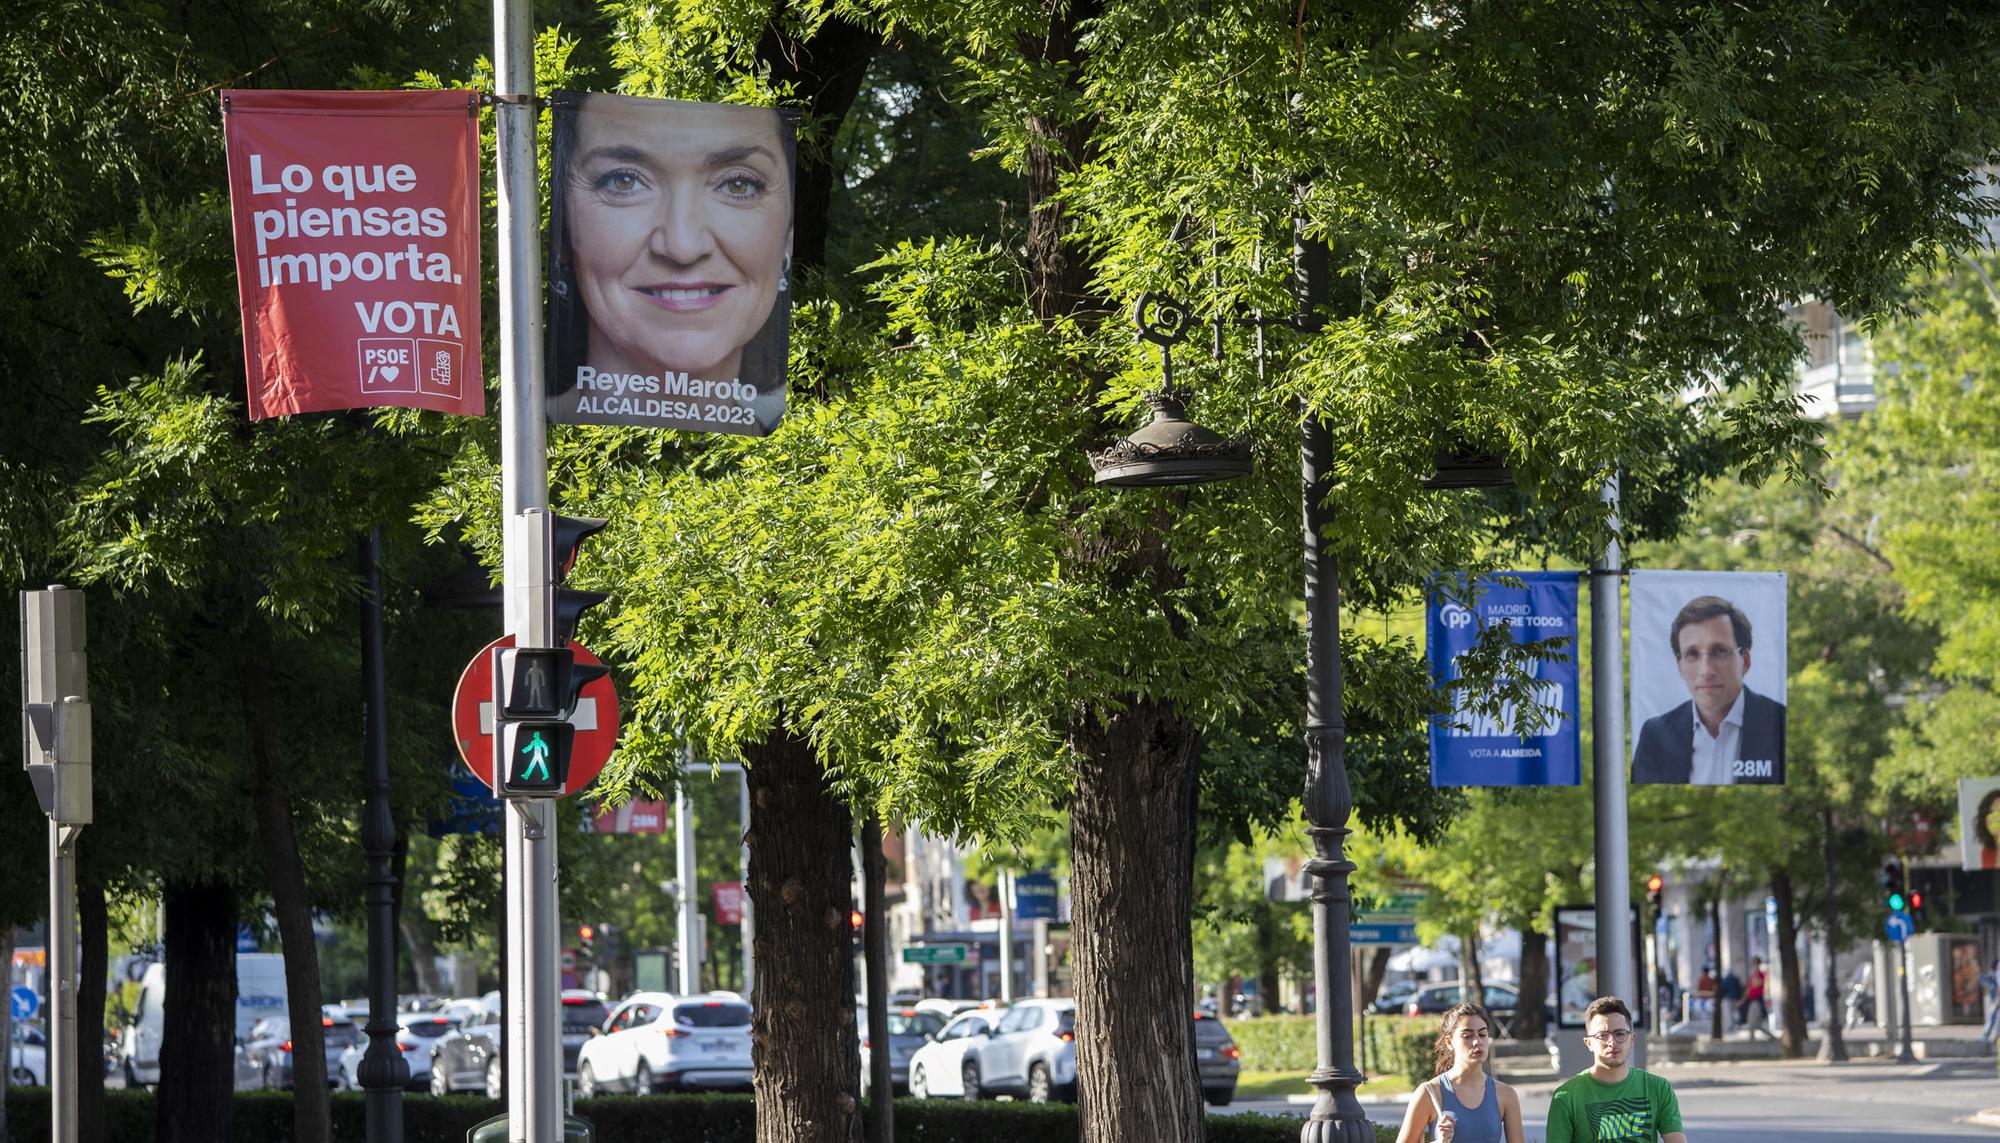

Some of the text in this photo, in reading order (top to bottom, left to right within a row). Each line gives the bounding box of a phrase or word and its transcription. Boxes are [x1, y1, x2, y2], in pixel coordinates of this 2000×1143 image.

[250, 154, 417, 200] Lo que
[254, 198, 448, 255] piensas
[258, 243, 462, 291] importa.
[355, 301, 462, 338] VOTA
[365, 349, 409, 365] PSOE
[576, 365, 757, 402] Reyes Maroto
[576, 396, 756, 425] ALCALDESA 2023
[1487, 604, 1531, 616] MADRID
[1527, 616, 1564, 627] TODOS
[1468, 747, 1542, 758] VOTA A ALMEIDA
[1732, 760, 1772, 777] 28M
